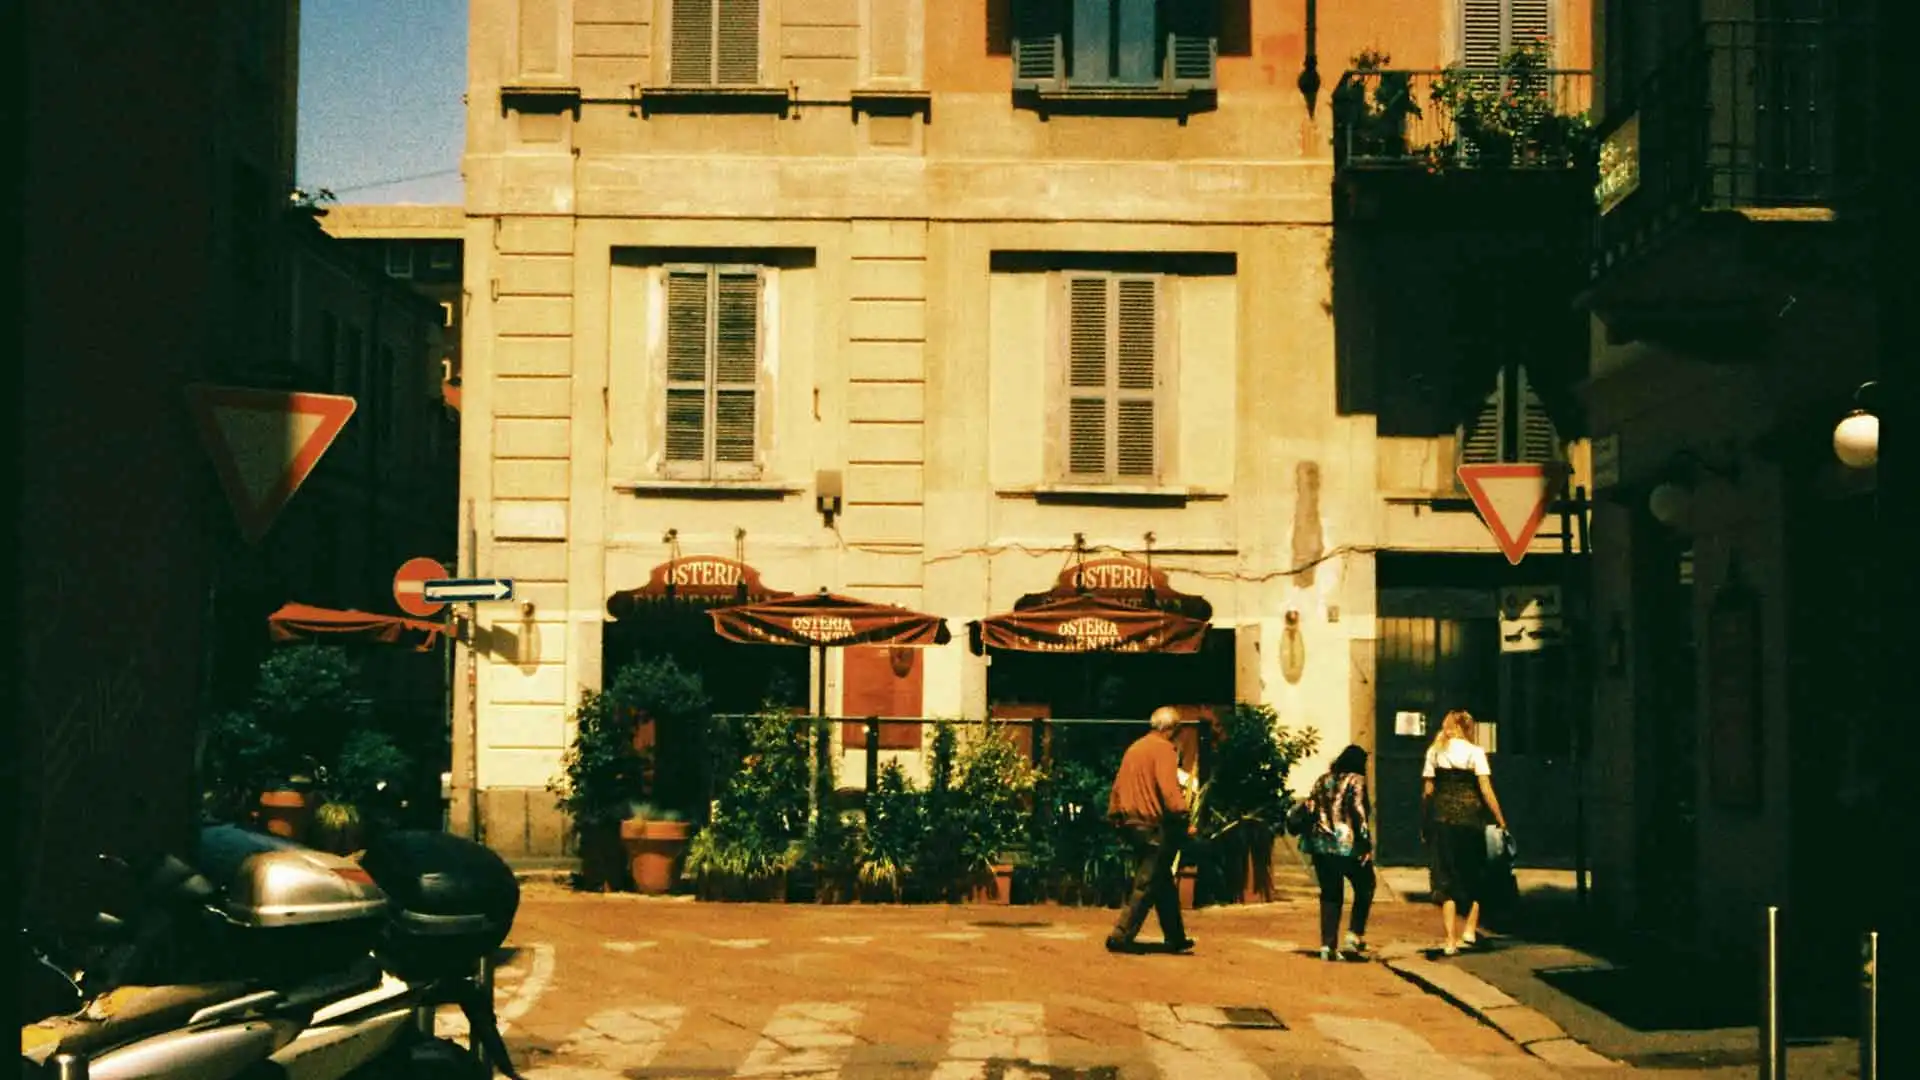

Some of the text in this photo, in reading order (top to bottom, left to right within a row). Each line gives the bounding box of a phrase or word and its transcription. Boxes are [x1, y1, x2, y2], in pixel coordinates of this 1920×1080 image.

[664, 561, 746, 586] OSTERIA
[1072, 564, 1154, 589] OSTERIA
[792, 616, 852, 630] OSTERIA
[1059, 617, 1118, 635] OSTERIA
